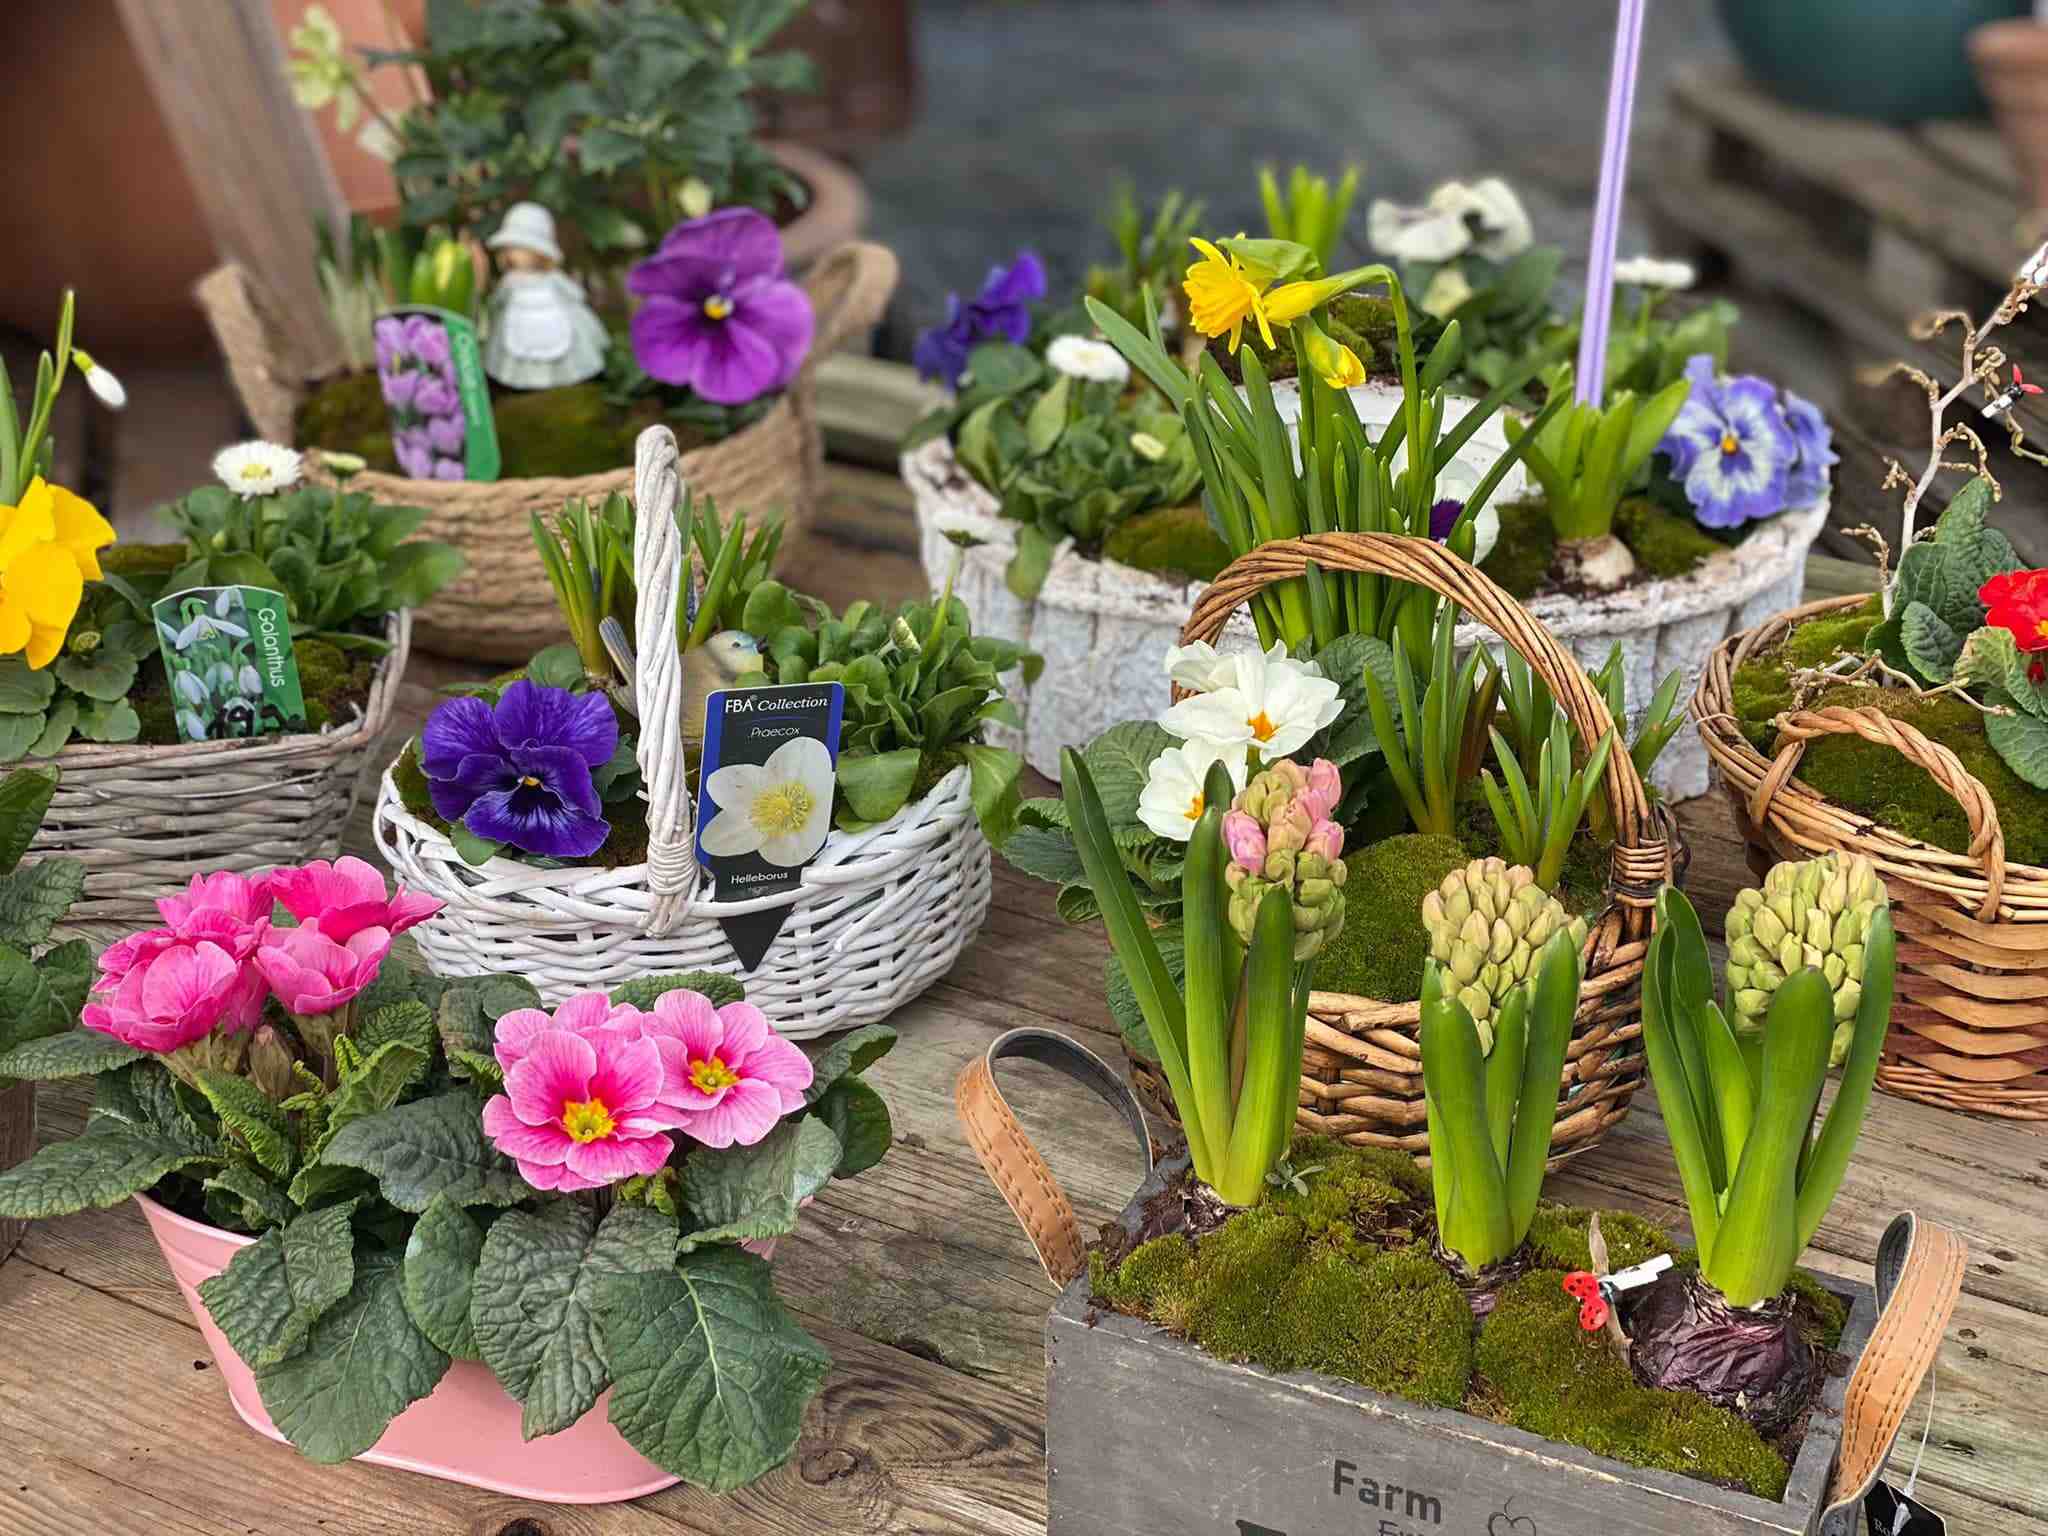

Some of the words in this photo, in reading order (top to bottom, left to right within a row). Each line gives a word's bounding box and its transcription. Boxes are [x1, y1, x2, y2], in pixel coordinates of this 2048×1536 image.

[258, 608, 285, 687] Galanthus
[758, 697, 828, 711] Collection
[751, 727, 800, 738] Praecox
[731, 872, 788, 884] Helleborus
[1333, 1459, 1441, 1524] Farm
